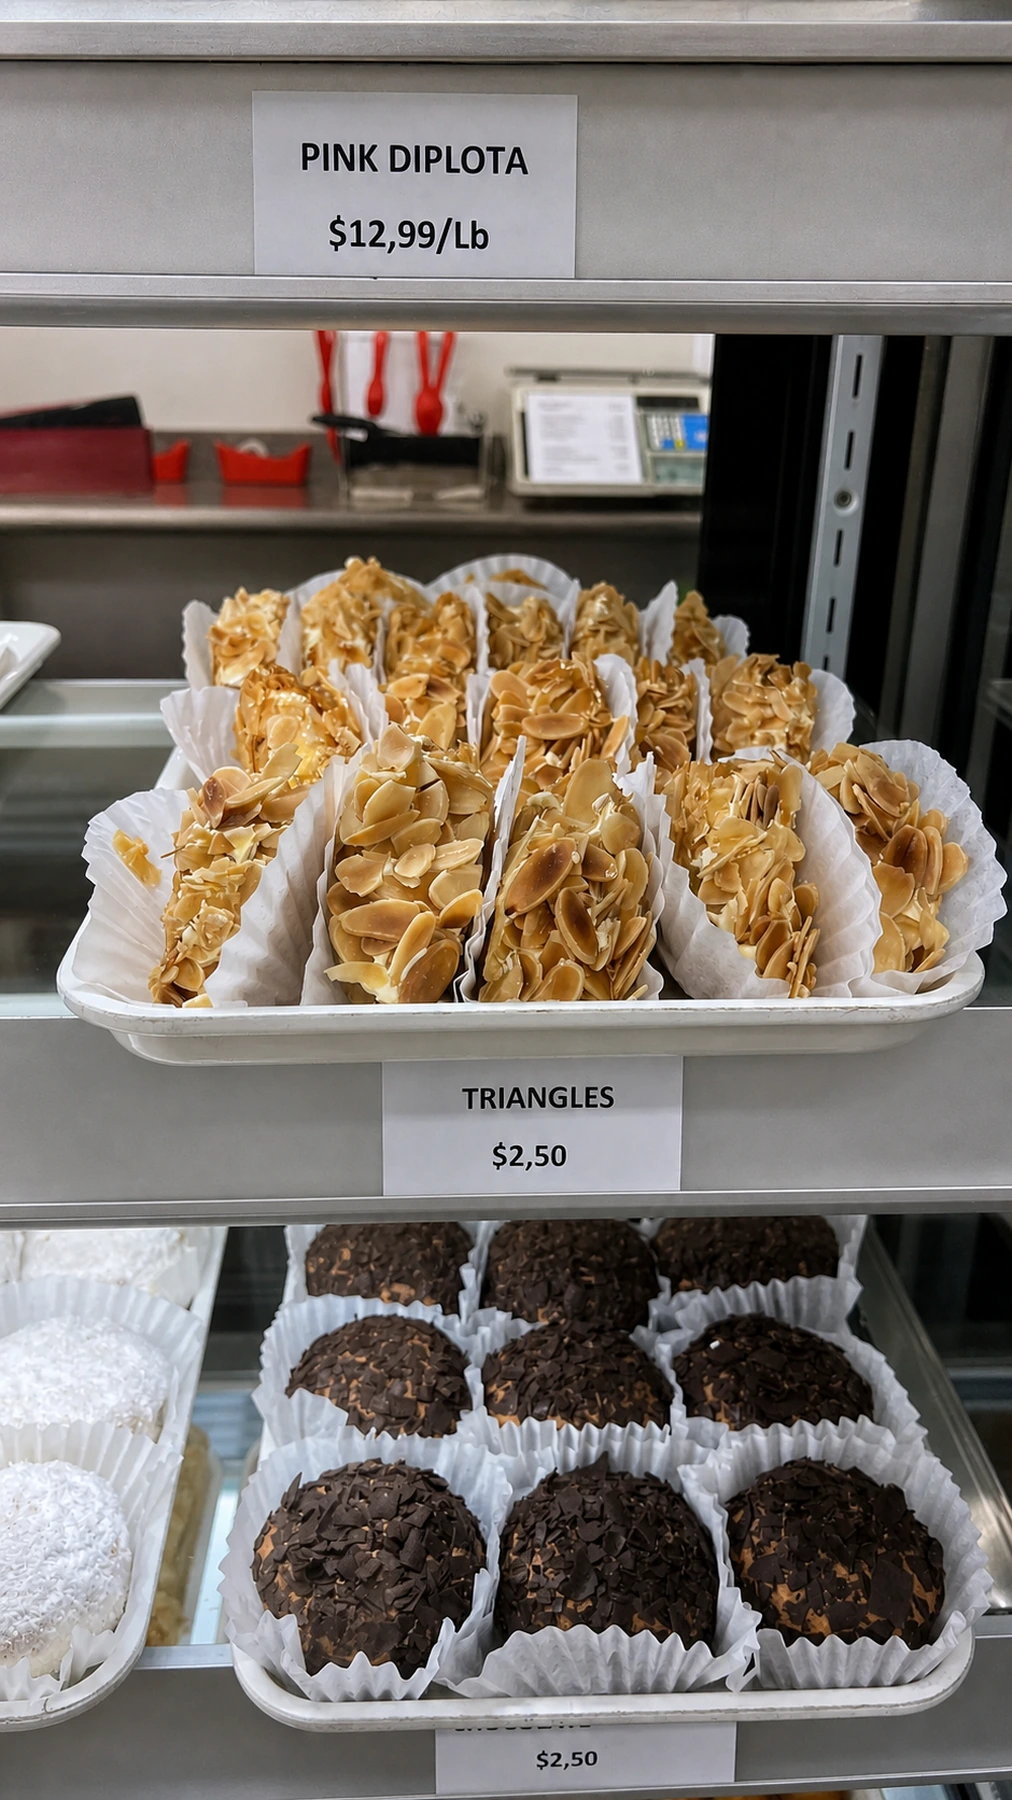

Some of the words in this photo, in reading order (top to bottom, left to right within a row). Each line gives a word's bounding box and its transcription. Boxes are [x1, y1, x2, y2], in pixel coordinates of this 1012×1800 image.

[301, 142, 378, 173] PINK
[389, 144, 529, 175] DIPLOTA
[329, 215, 489, 254] $12,99/Lb
[461, 1085, 615, 1110] TRIANGLES
[491, 1141, 567, 1171] $2,50
[536, 1749, 598, 1770] $2,50
